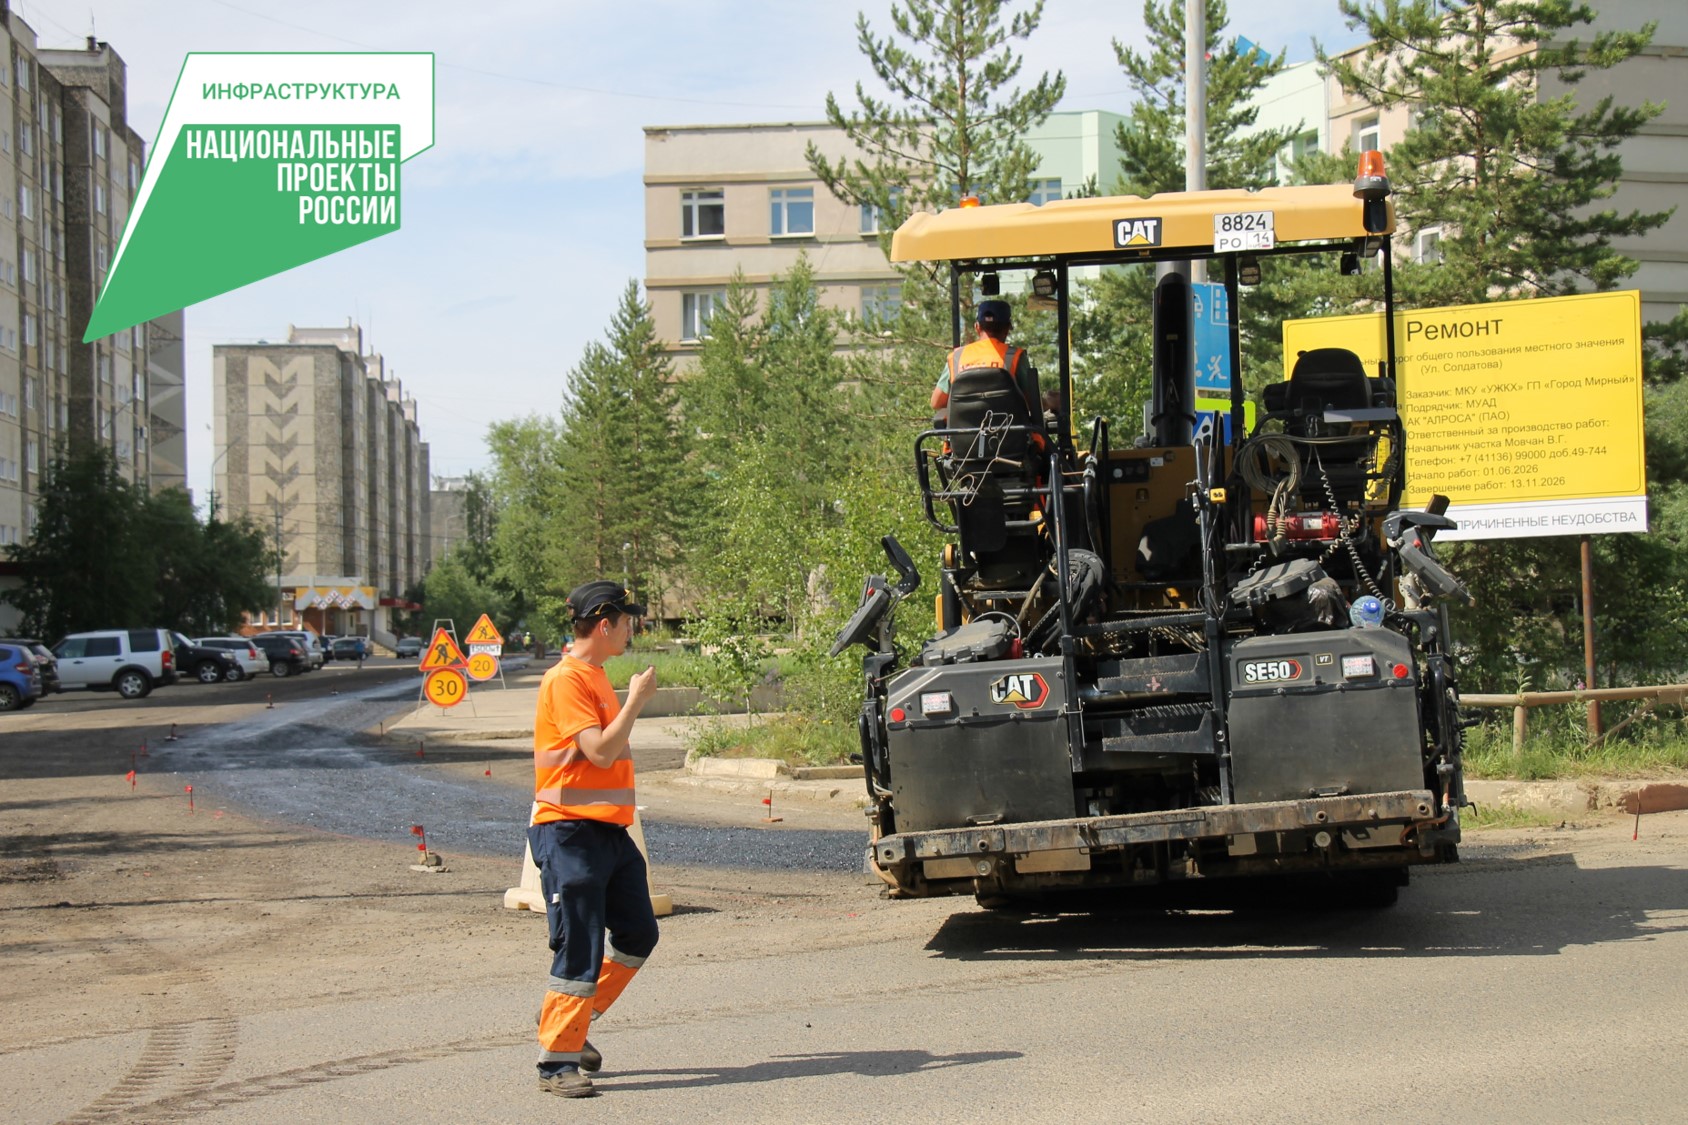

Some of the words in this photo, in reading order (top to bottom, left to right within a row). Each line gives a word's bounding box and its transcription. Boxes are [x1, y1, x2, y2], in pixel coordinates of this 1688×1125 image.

[1222, 213, 1266, 232] 8824
[1117, 220, 1157, 246] CAT
[1220, 237, 1242, 249] РО
[1253, 232, 1269, 243] 14
[1407, 318, 1503, 342] Ремонт
[1416, 351, 1453, 363] общего
[1456, 346, 1521, 359] пользования
[1524, 342, 1572, 353] местного
[1575, 338, 1625, 349] значения
[1421, 365, 1440, 376] (Ул.
[1443, 359, 1502, 373] Солдатова)
[1406, 390, 1452, 400] Заказчик:
[1455, 386, 1477, 395] МКУ
[1481, 382, 1523, 394] «УЖКХ»
[1527, 381, 1541, 390] ГП
[1544, 379, 1582, 390] «Город
[1585, 375, 1635, 387] Мирный»
[1406, 403, 1463, 414] Подрядчик:
[1466, 398, 1497, 409] МУАД
[1407, 417, 1421, 426] АК
[1423, 413, 1475, 425] "АЛРОСА"
[1479, 411, 1510, 422] (ПАО)
[1407, 428, 1484, 440] Ответственный
[1487, 427, 1498, 435] за
[1501, 421, 1573, 435] производство
[1576, 419, 1610, 431] работ:
[1407, 443, 1460, 454] Начальник
[1463, 440, 1501, 452] участка
[1505, 436, 1544, 447] Мовчан
[1547, 434, 1567, 445] В.Г.
[1408, 457, 1456, 468] Телефон:
[1460, 455, 1472, 463] +7
[1475, 452, 1513, 465] (41136)
[1515, 449, 1546, 460] 99000
[1549, 446, 1607, 459] доб.49-744
[1408, 471, 1445, 481] Начало
[1448, 469, 1480, 480] работ:
[1483, 464, 1539, 476] 01.06.2026
[1408, 483, 1471, 494] Завершение
[1474, 481, 1507, 492] работ:
[1511, 476, 1566, 489] 13.11.2026
[1552, 511, 1638, 526] НЕУДОБСТВА
[473, 660, 490, 672] 20
[1245, 661, 1290, 682] SE50
[435, 679, 457, 696] 30
[992, 675, 1034, 703] CAT
